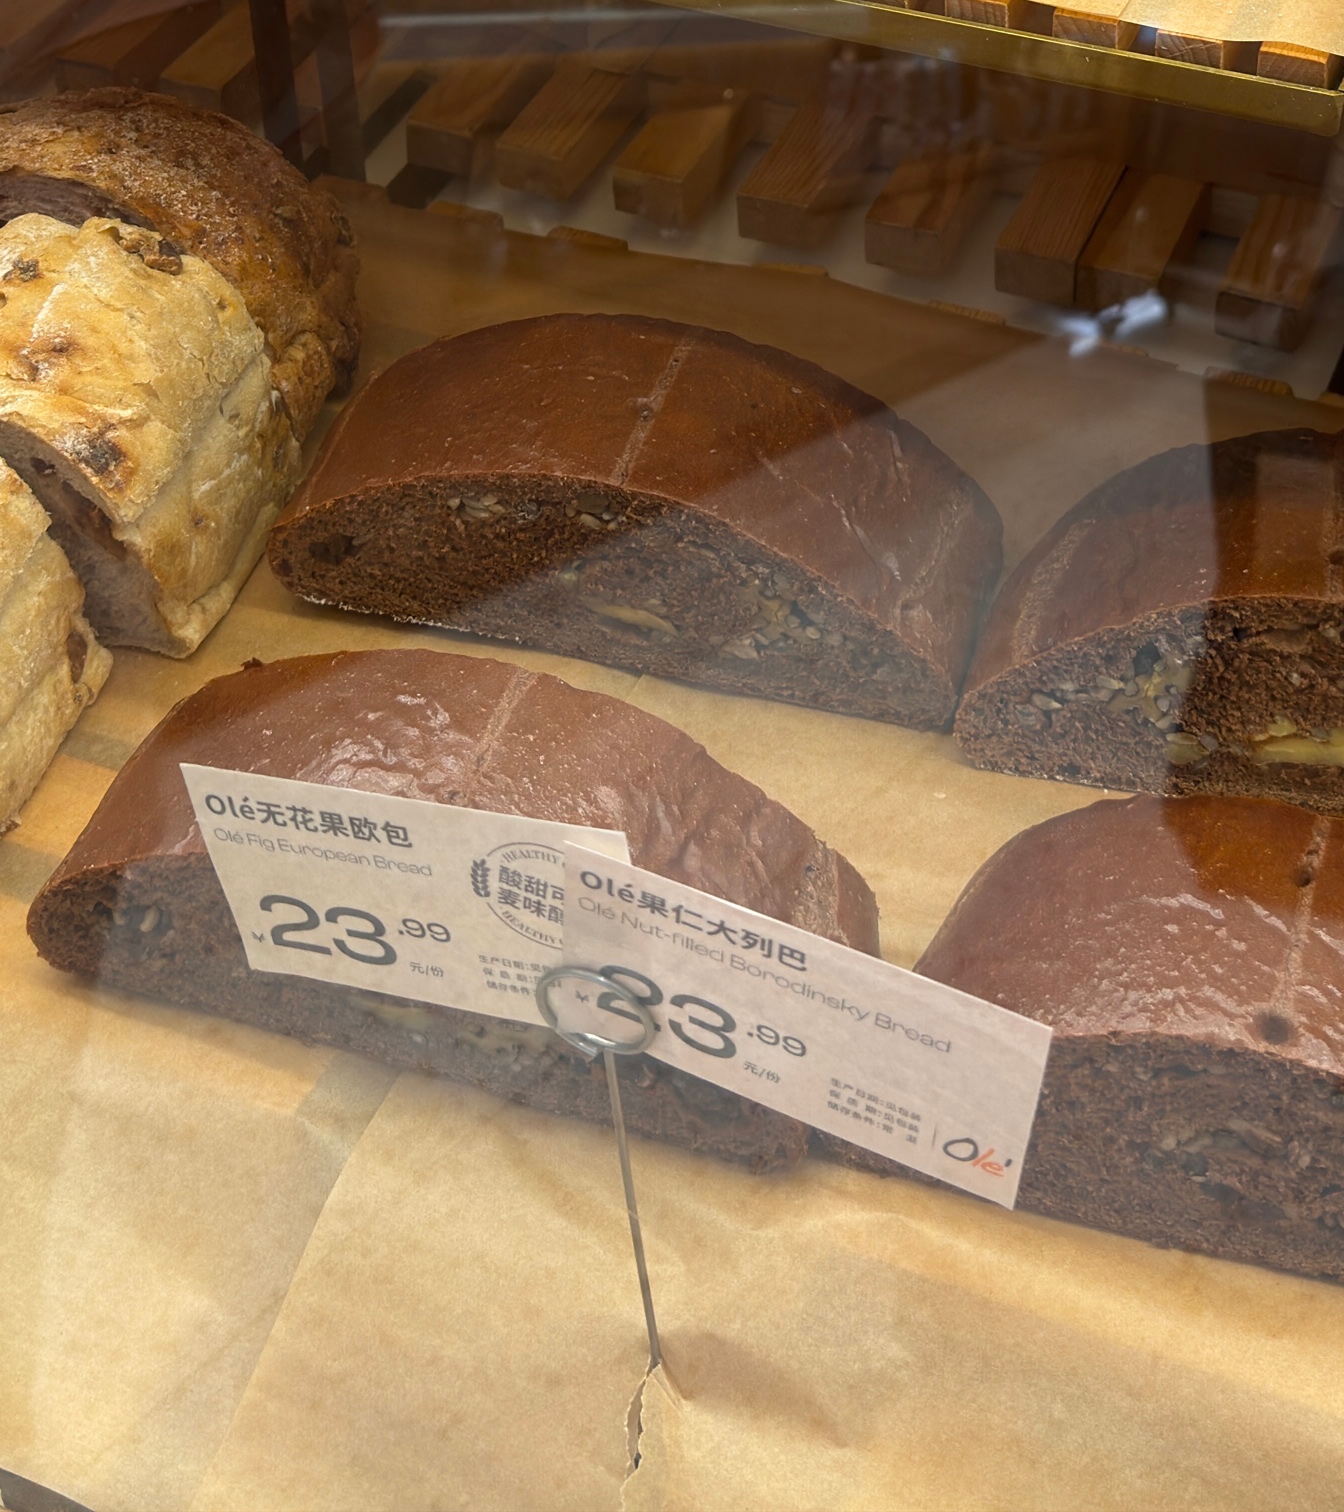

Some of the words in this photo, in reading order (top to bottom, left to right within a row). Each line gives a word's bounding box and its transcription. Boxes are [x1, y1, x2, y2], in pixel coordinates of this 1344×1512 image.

[205, 794, 413, 849] Olé无花果欧包
[213, 827, 244, 845] Olé
[246, 833, 276, 853] Fig
[278, 841, 371, 868] European
[373, 855, 433, 877] Bread
[259, 894, 452, 966] 23.99
[580, 870, 808, 973] Olé果仁大列巴
[578, 896, 617, 921] Olé
[620, 911, 725, 964] Nut-filled
[729, 954, 870, 1022] Borodinsky
[874, 1012, 954, 1054] Bread
[942, 1137, 1013, 1178] Olé
